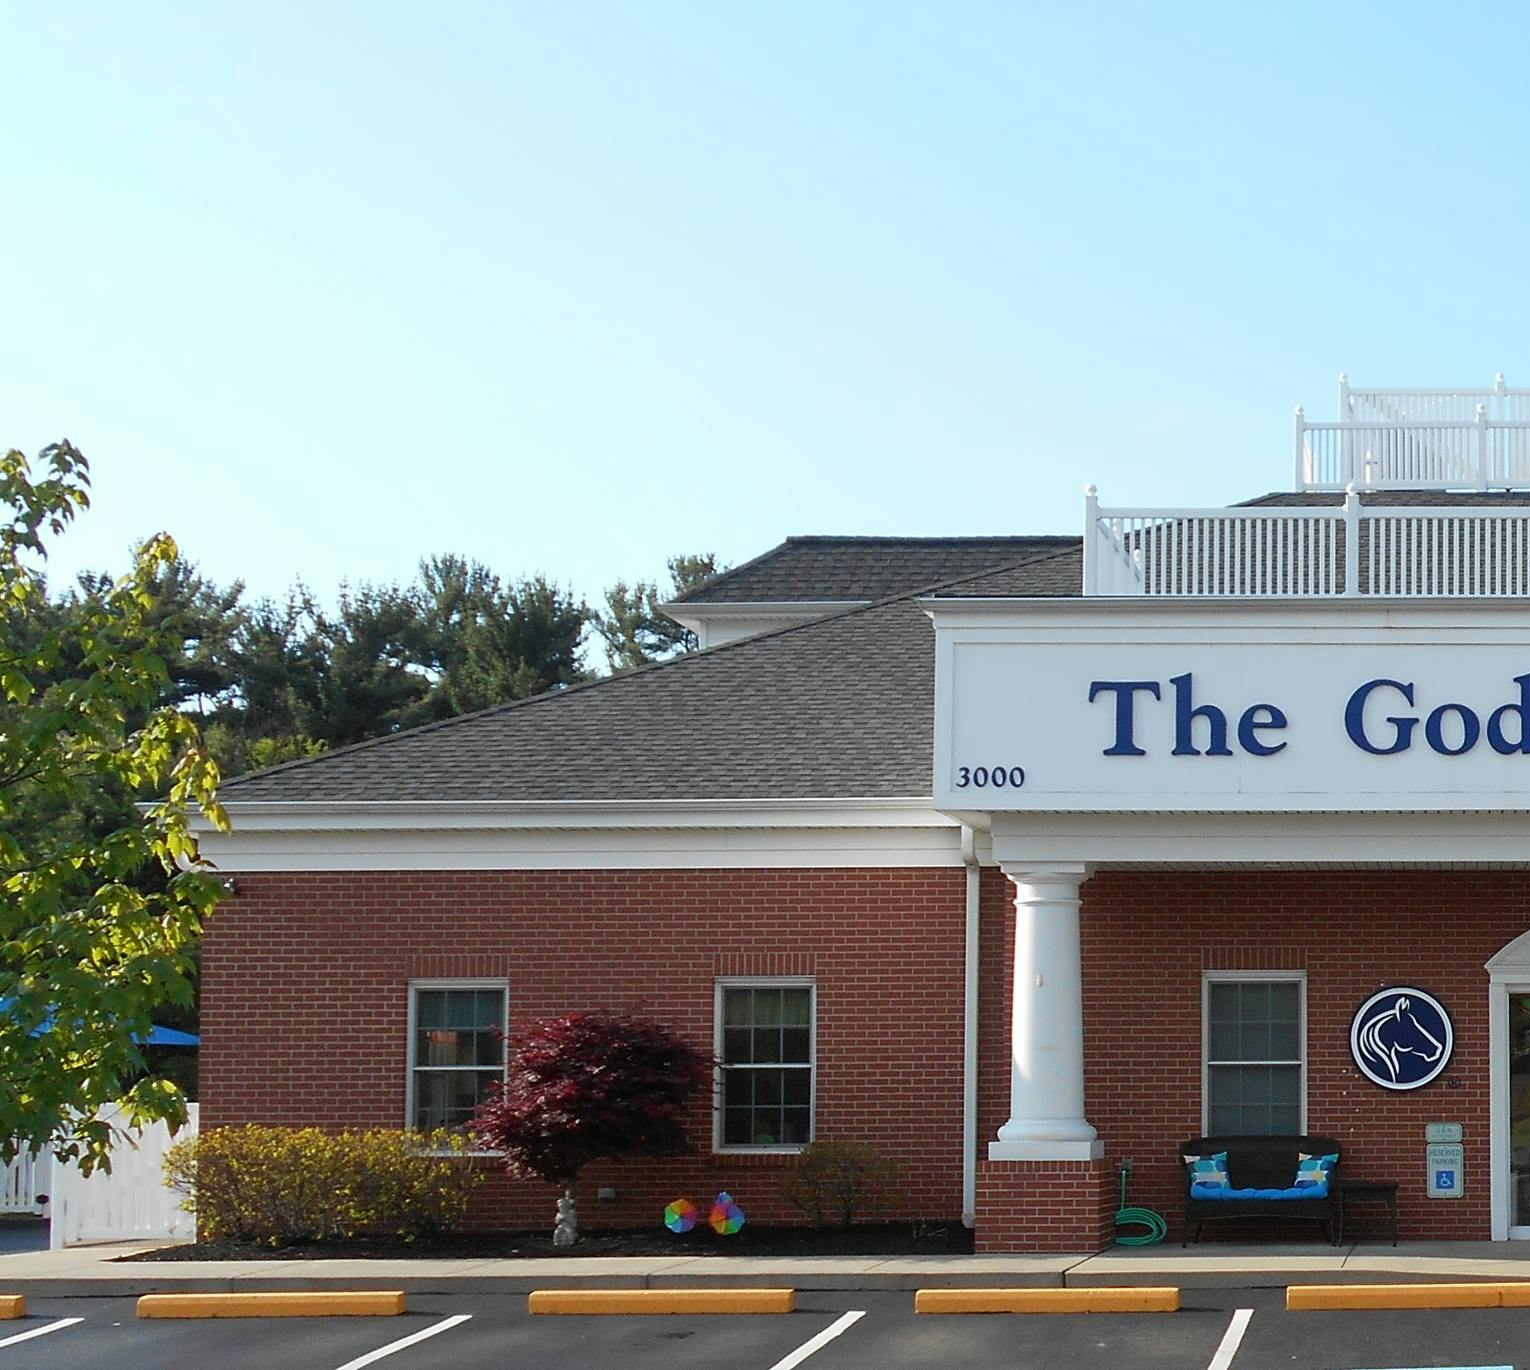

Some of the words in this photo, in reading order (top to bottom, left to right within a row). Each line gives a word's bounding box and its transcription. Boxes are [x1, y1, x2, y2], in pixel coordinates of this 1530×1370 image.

[1088, 672, 1289, 758] The
[955, 766, 1026, 789] 3000
[1430, 1149, 1460, 1157] RESERVED
[1431, 1158, 1458, 1166] PARKING
